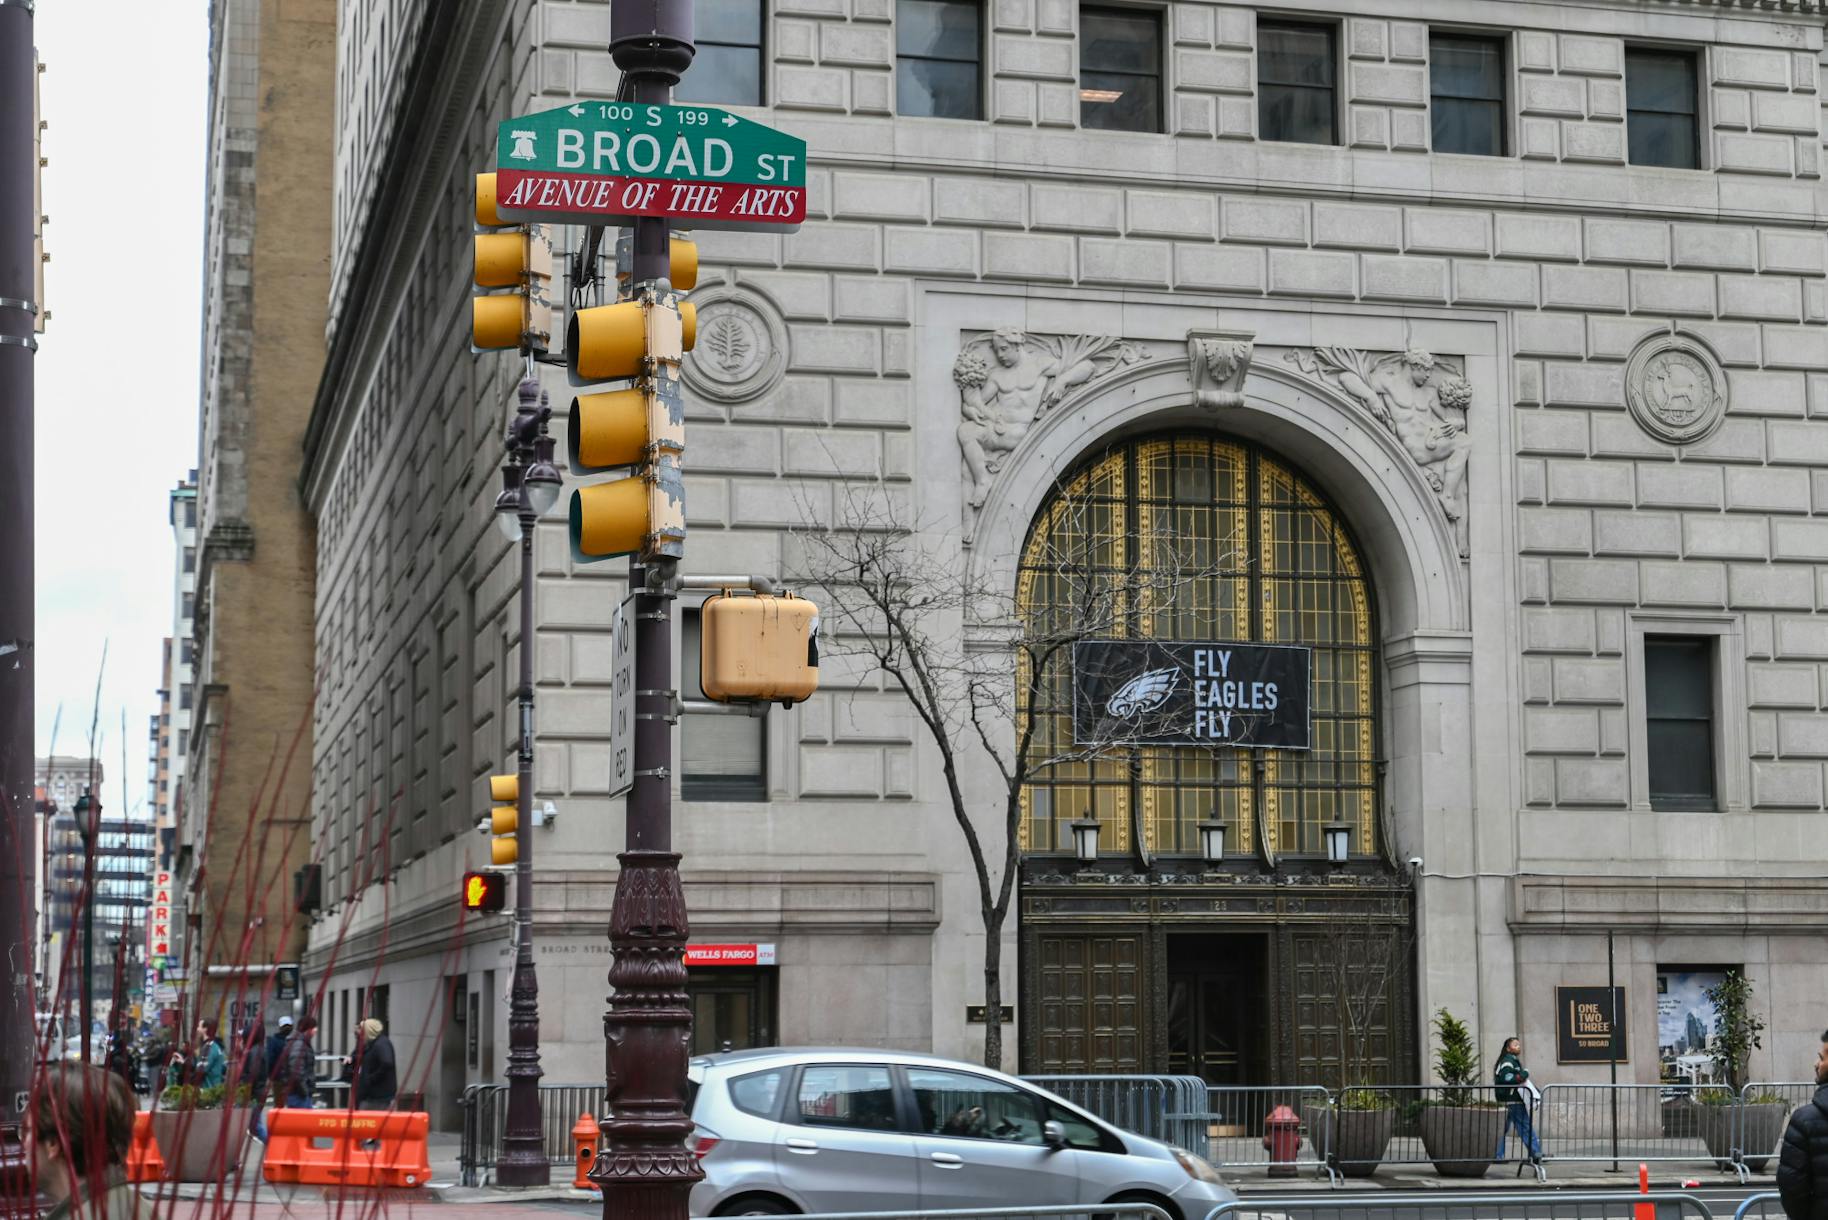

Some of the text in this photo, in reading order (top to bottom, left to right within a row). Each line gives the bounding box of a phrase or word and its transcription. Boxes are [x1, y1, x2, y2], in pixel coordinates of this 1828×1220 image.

[599, 105, 709, 127] 100 S 199
[556, 128, 796, 182] BROAD ST
[505, 179, 799, 217] AVENUE OF THE ARTS
[617, 619, 629, 659] NO
[1194, 650, 1231, 677] FLY
[616, 664, 631, 699] TURN
[1194, 680, 1278, 710] EAGLES
[618, 706, 627, 737] ON
[1195, 710, 1232, 738] FLY
[615, 747, 627, 778] RED
[155, 873, 169, 936] PARK
[541, 945, 577, 954] BROAD
[687, 950, 720, 959] WELLS
[722, 950, 755, 959] FARGO
[1578, 1003, 1599, 1013] ONE
[1579, 1013, 1602, 1022] TWO
[1579, 1022, 1610, 1032] THREE
[340, 1119, 377, 1129] TAFFIC
